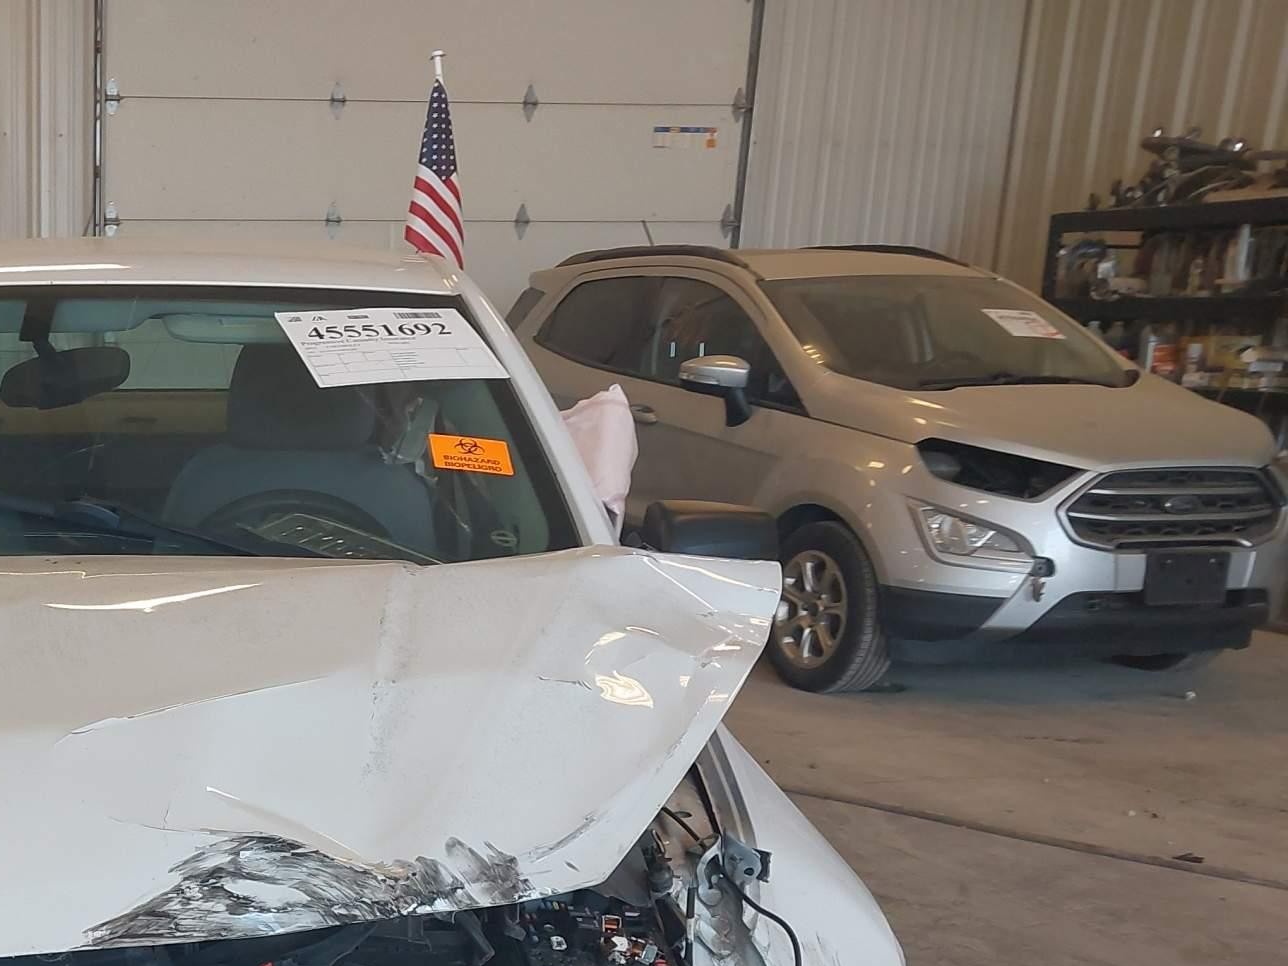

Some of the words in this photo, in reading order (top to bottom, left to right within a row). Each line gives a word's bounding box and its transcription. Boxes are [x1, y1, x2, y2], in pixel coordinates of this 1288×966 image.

[308, 323, 452, 339] 45551692
[443, 455, 501, 465] BIOHAZARD
[444, 461, 502, 472] BIOPELIGRO
